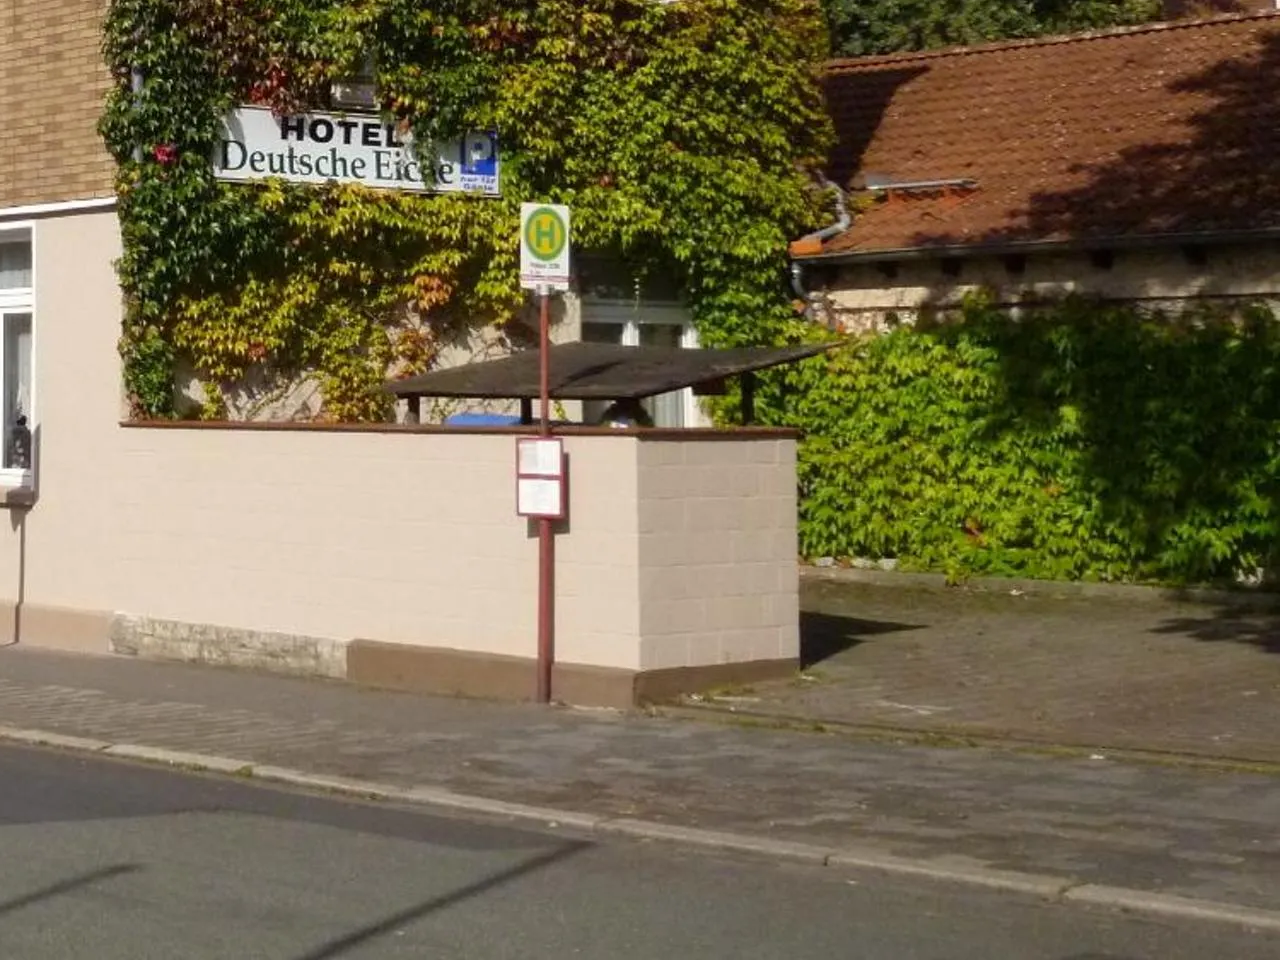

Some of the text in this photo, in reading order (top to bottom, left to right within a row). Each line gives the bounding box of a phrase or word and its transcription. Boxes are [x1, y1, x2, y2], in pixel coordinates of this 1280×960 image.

[280, 117, 404, 148] HOTEL
[220, 140, 454, 184] Deutsche Eice
[536, 219, 554, 248] H
